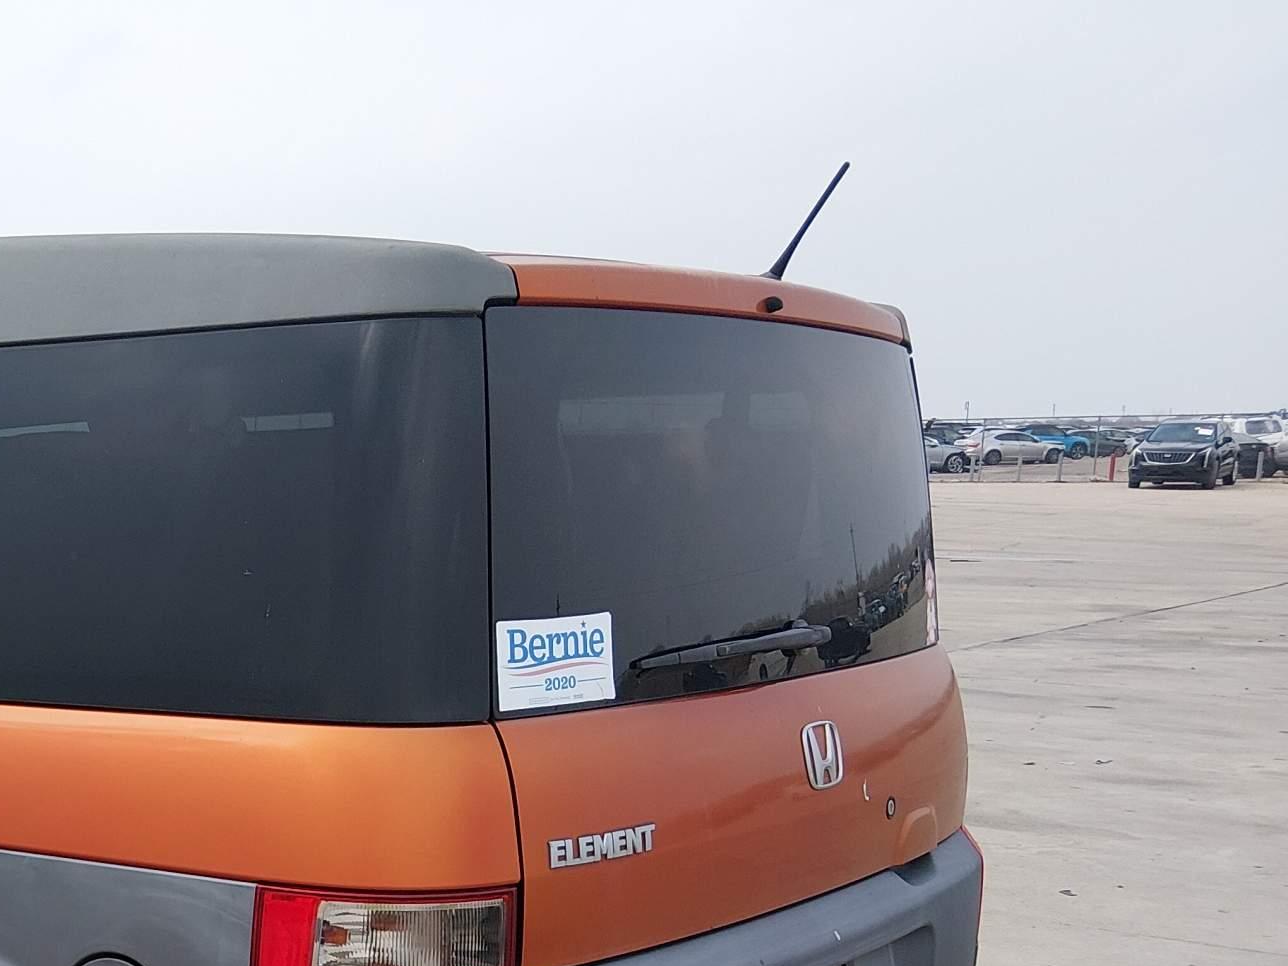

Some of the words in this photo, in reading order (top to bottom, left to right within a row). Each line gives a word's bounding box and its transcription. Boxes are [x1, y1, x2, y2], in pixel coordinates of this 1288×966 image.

[506, 620, 605, 665] Bernie
[544, 675, 577, 692] 2020
[547, 822, 657, 870] ELEMENT
